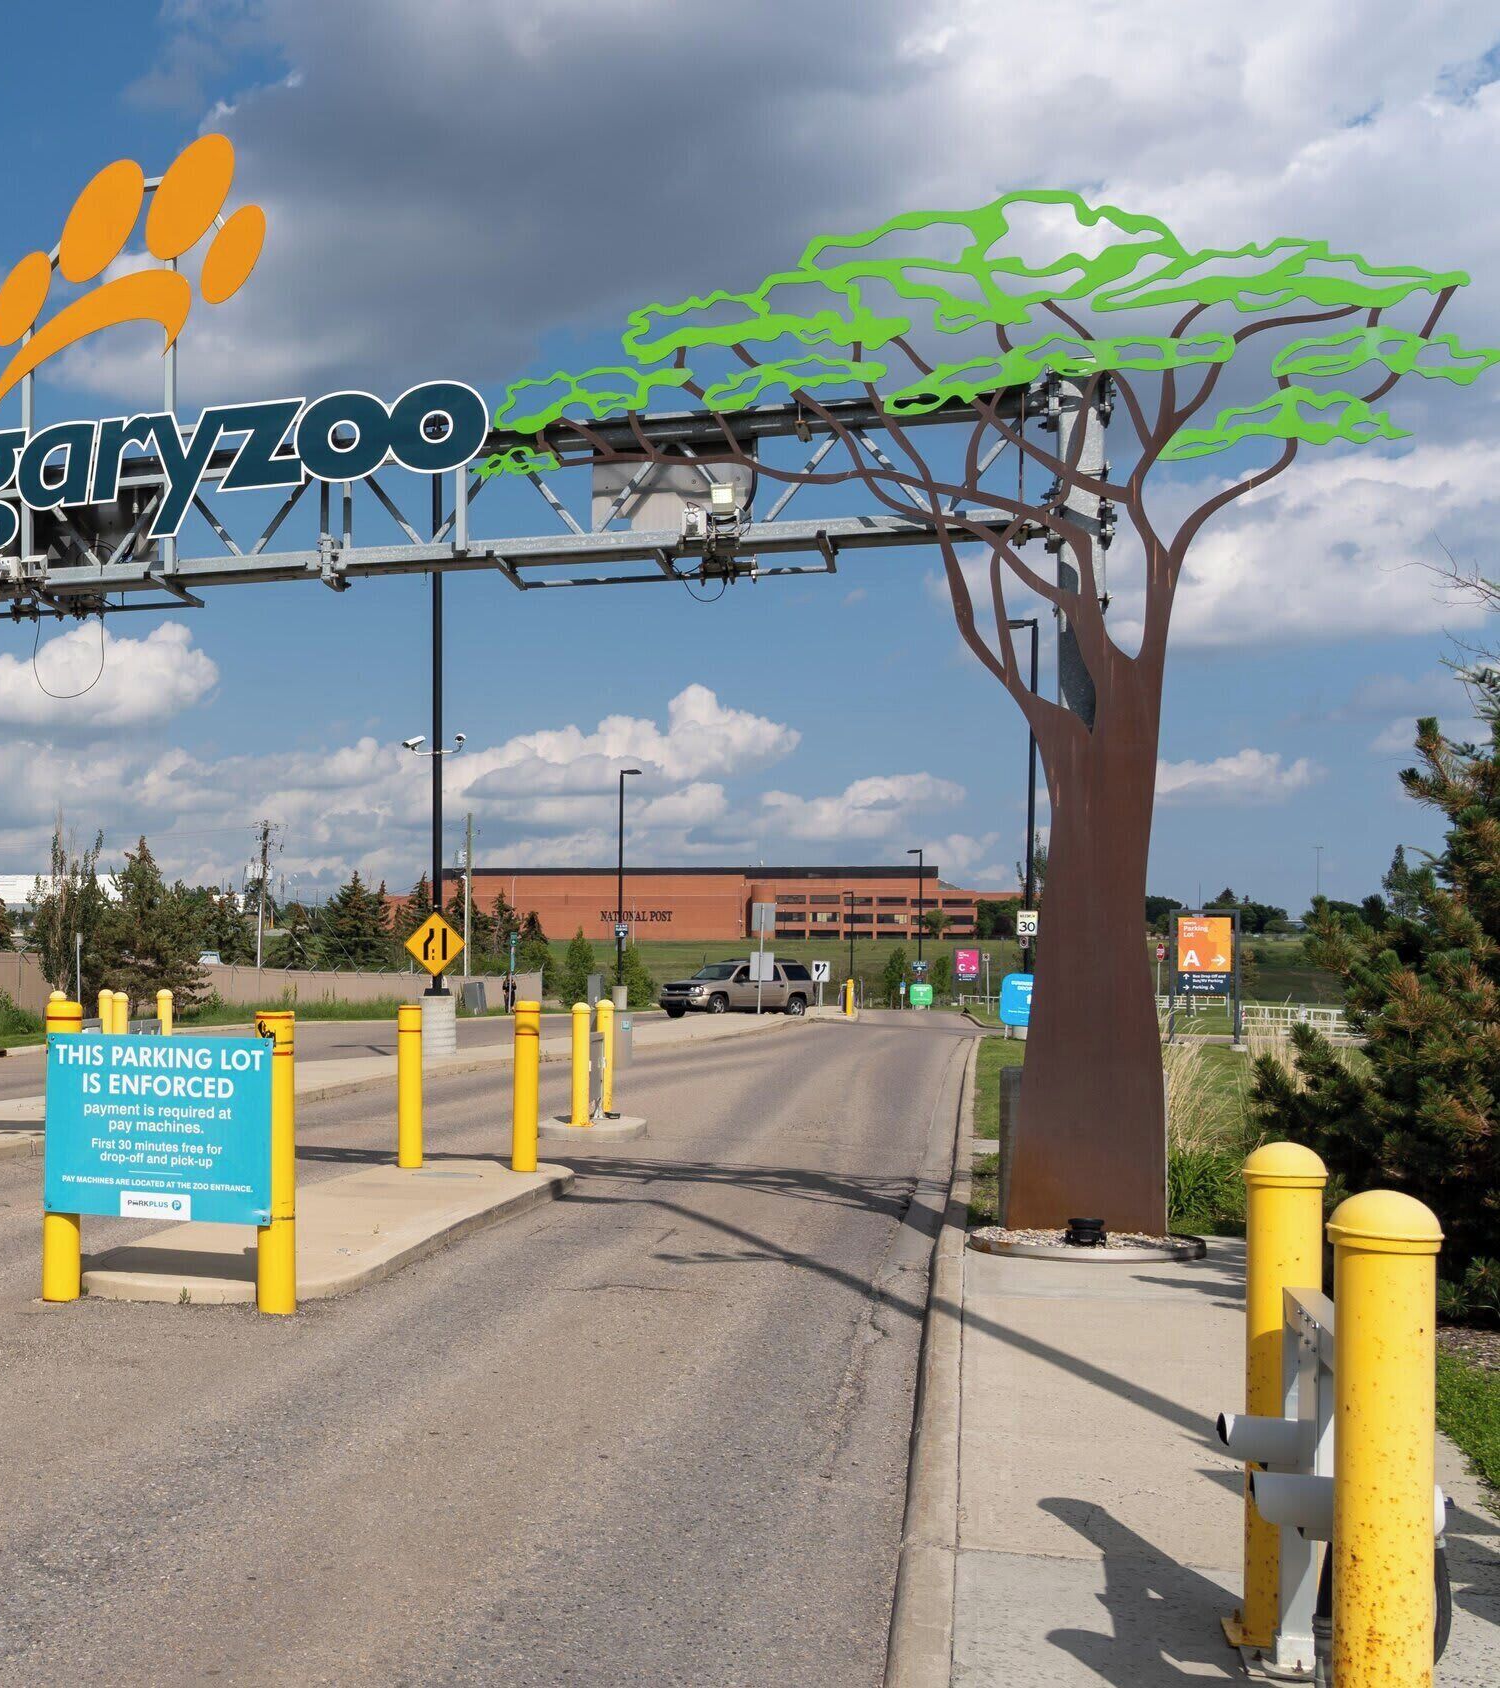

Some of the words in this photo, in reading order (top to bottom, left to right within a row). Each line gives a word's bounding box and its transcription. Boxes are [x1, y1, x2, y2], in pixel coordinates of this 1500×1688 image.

[600, 911, 648, 921] NATONAL
[650, 911, 673, 921] POST
[1019, 921, 1036, 932] 30
[1182, 950, 1202, 967] A
[958, 963, 966, 972] C
[56, 1044, 103, 1066] THIS
[112, 1047, 212, 1070] PARKING
[221, 1049, 264, 1071] LOT
[82, 1073, 100, 1094] IS
[109, 1074, 234, 1099] ENFORCED
[84, 1103, 140, 1117] payment
[143, 1105, 154, 1117] is
[158, 1106, 215, 1121] required
[219, 1108, 231, 1120] at
[109, 1120, 132, 1133] pay
[136, 1120, 204, 1134] machines.
[91, 1138, 115, 1150] First
[118, 1140, 132, 1150] 30
[134, 1140, 178, 1153] minutes
[181, 1142, 203, 1154] free
[206, 1143, 222, 1155] for
[100, 1151, 143, 1165] drop-off
[147, 1153, 167, 1165] and
[170, 1154, 213, 1168] pick-up
[62, 1175, 75, 1183] PAY
[76, 1175, 114, 1185] MACHINES
[115, 1177, 130, 1186] ARE
[131, 1178, 164, 1188] LOCATED
[166, 1180, 175, 1188] AT
[177, 1181, 191, 1190] THE
[193, 1182, 209, 1191] ZOO
[210, 1183, 253, 1193] ENTRANCE.
